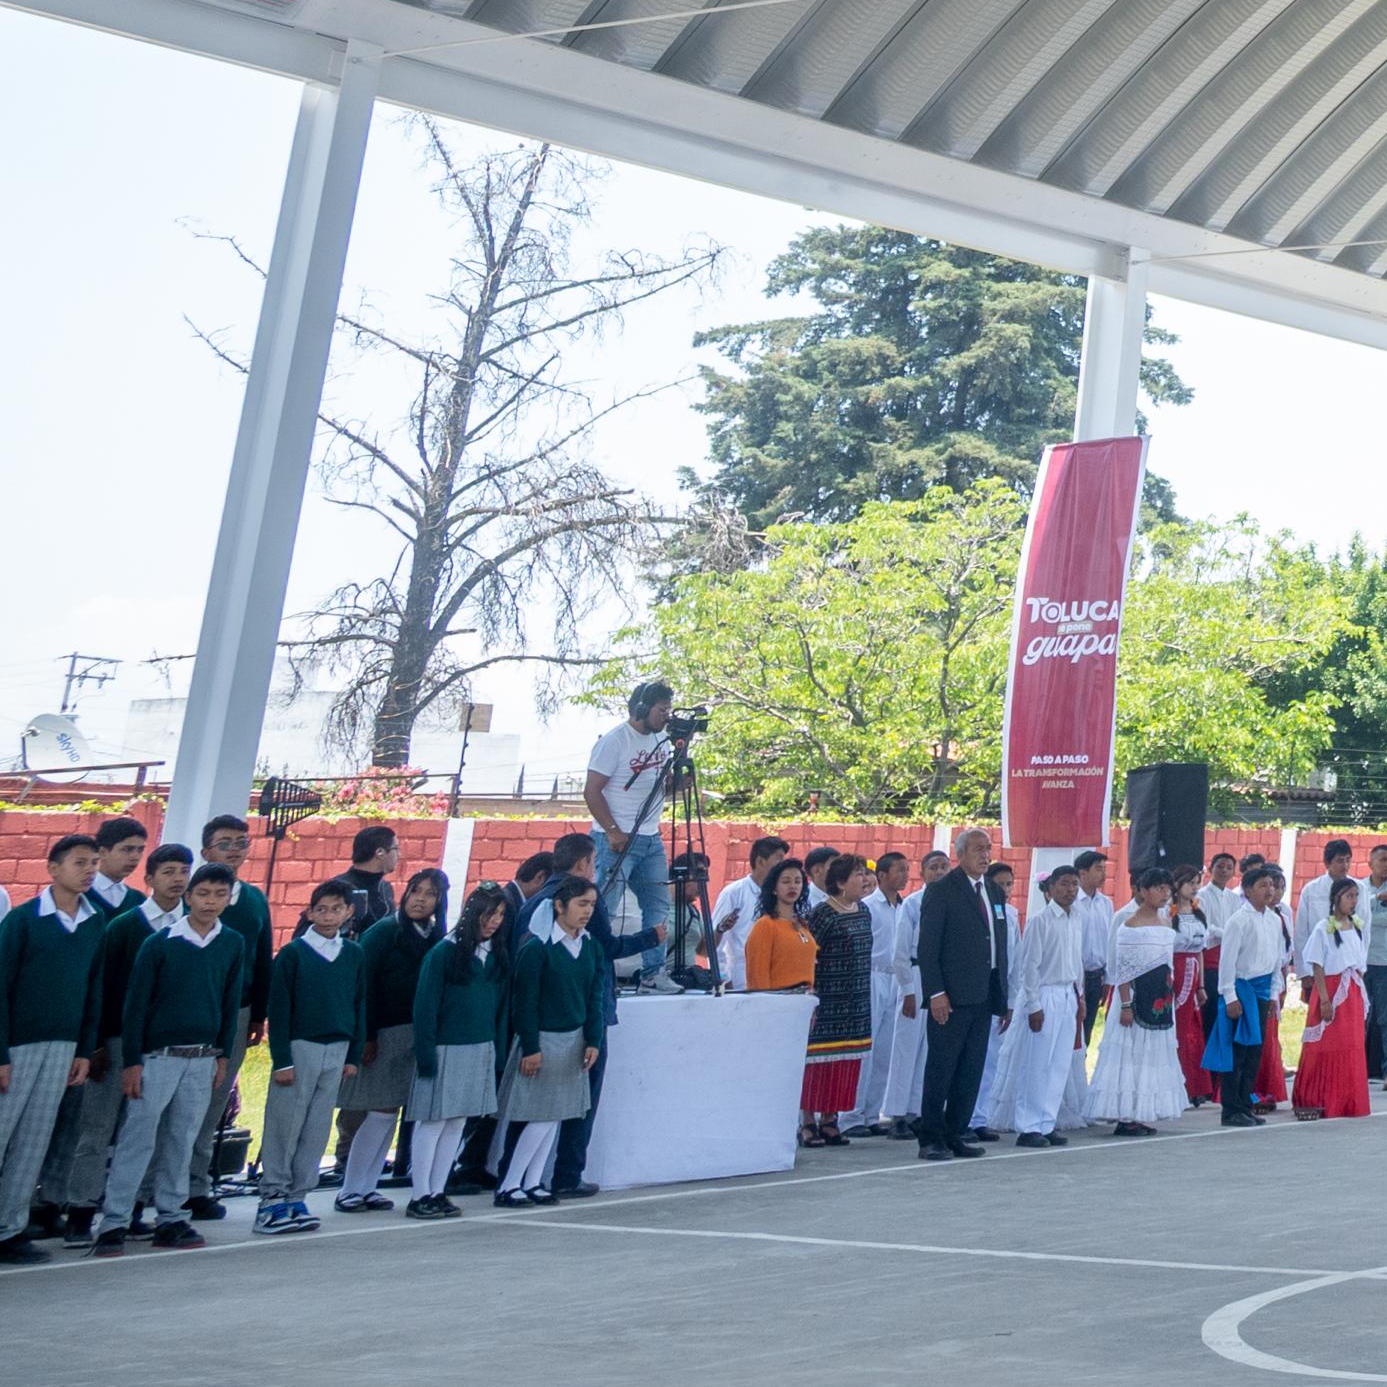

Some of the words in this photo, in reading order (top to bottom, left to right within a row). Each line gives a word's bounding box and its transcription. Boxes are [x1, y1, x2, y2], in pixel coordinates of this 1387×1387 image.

[1026, 597, 1119, 624] TOLUCA
[1022, 633, 1116, 666] guapa
[1030, 755, 1054, 765] PASO
[1054, 755, 1062, 764] A
[1062, 754, 1089, 765] PASO
[1011, 769, 1023, 778] LA
[1023, 766, 1105, 778] TRANSFORMACIÓN
